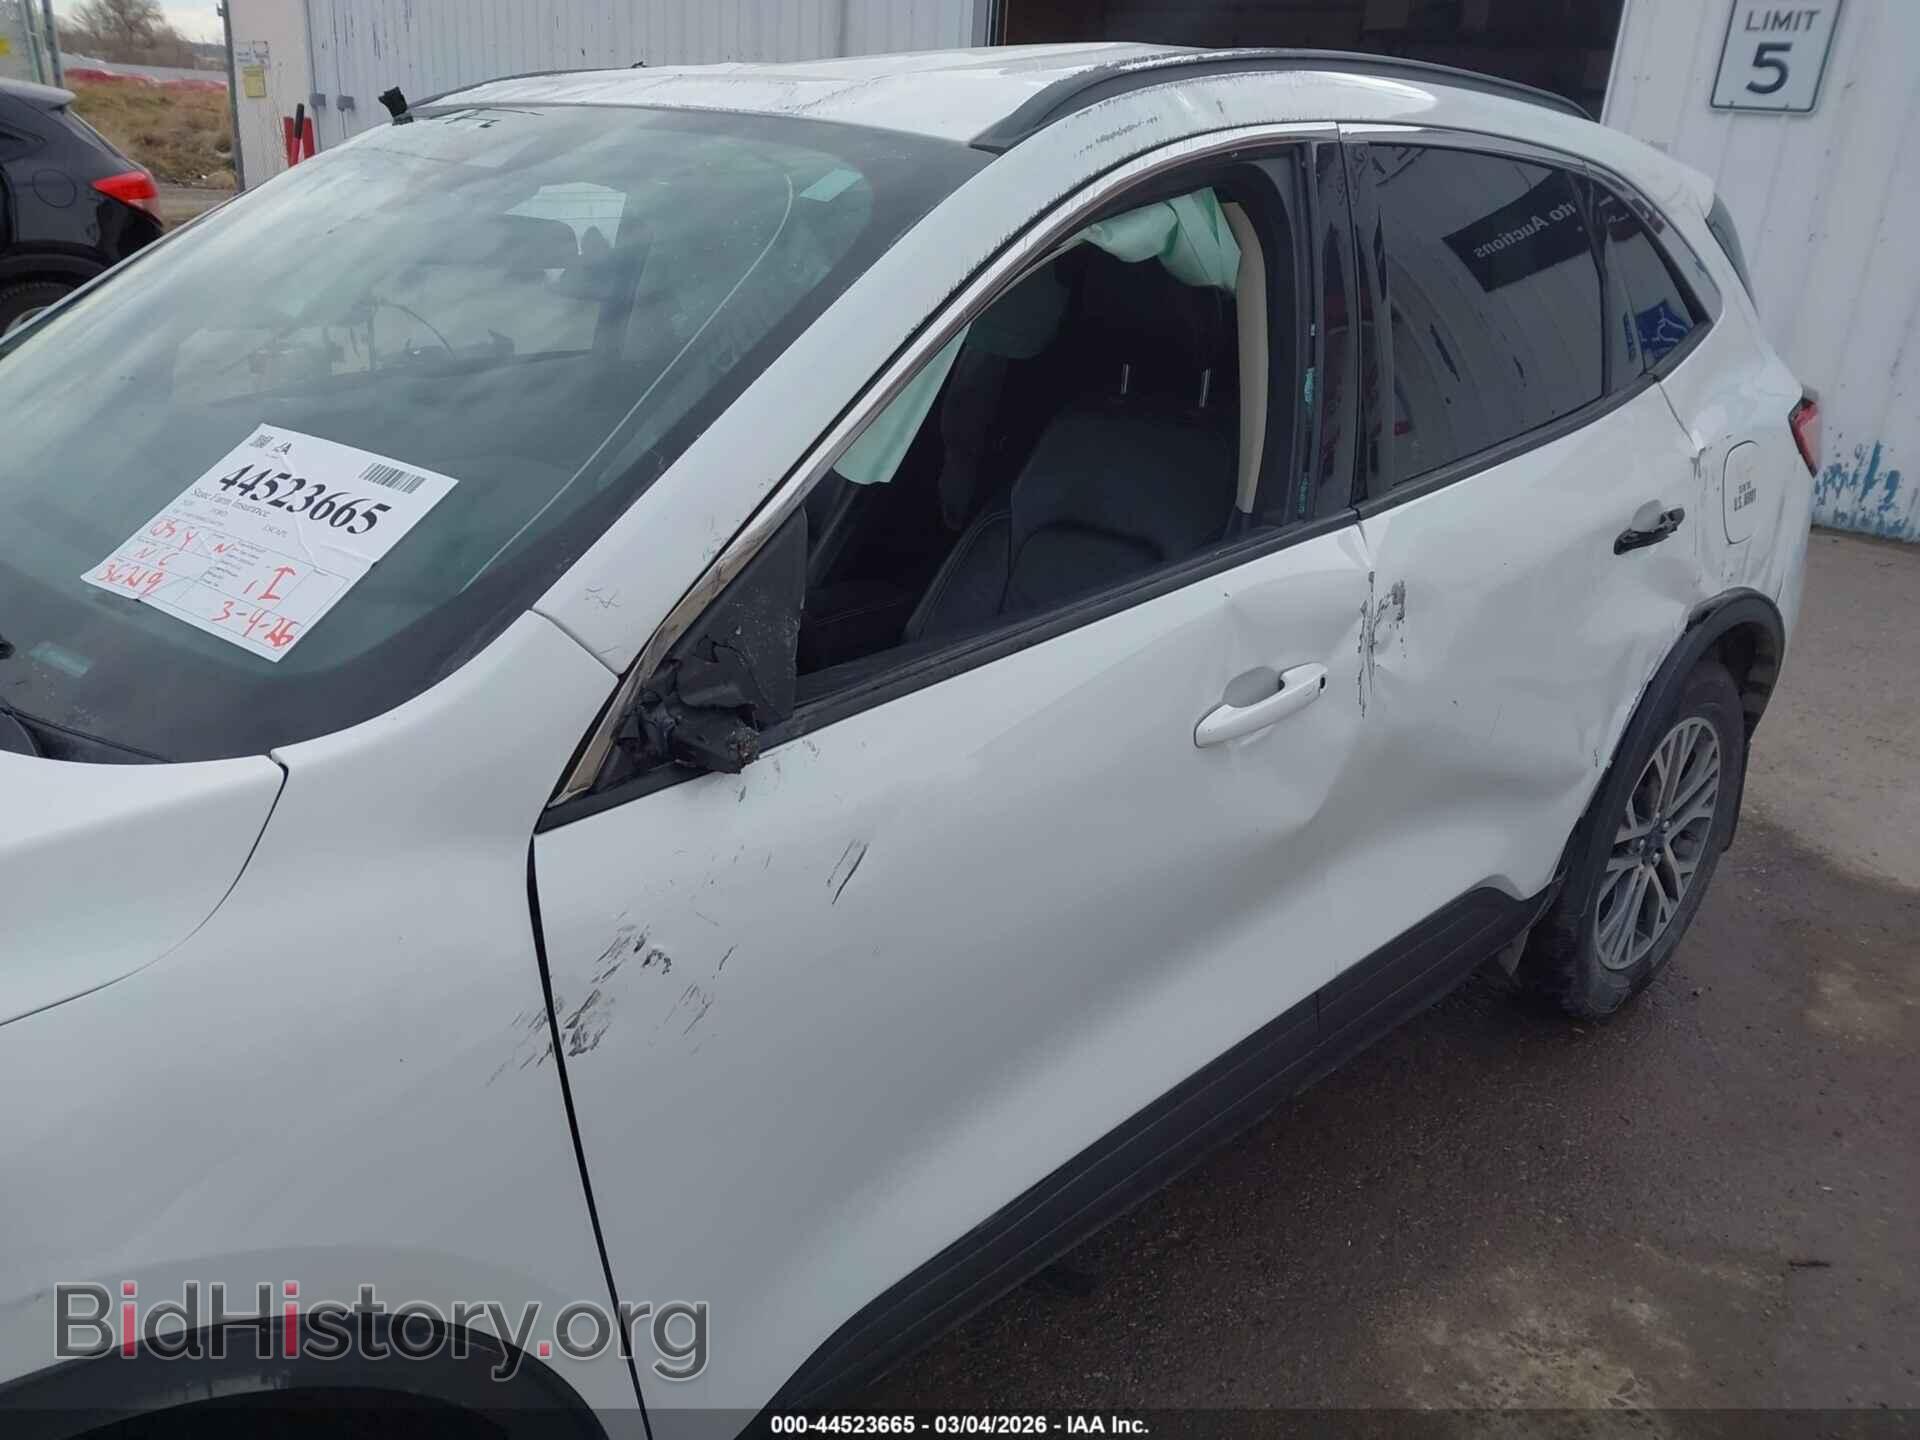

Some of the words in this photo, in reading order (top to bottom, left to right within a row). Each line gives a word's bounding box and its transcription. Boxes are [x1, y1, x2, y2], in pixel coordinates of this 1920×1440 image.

[1744, 10, 1821, 32] LIMIT
[1745, 42, 1793, 94] 5
[219, 464, 392, 534] 44523665
